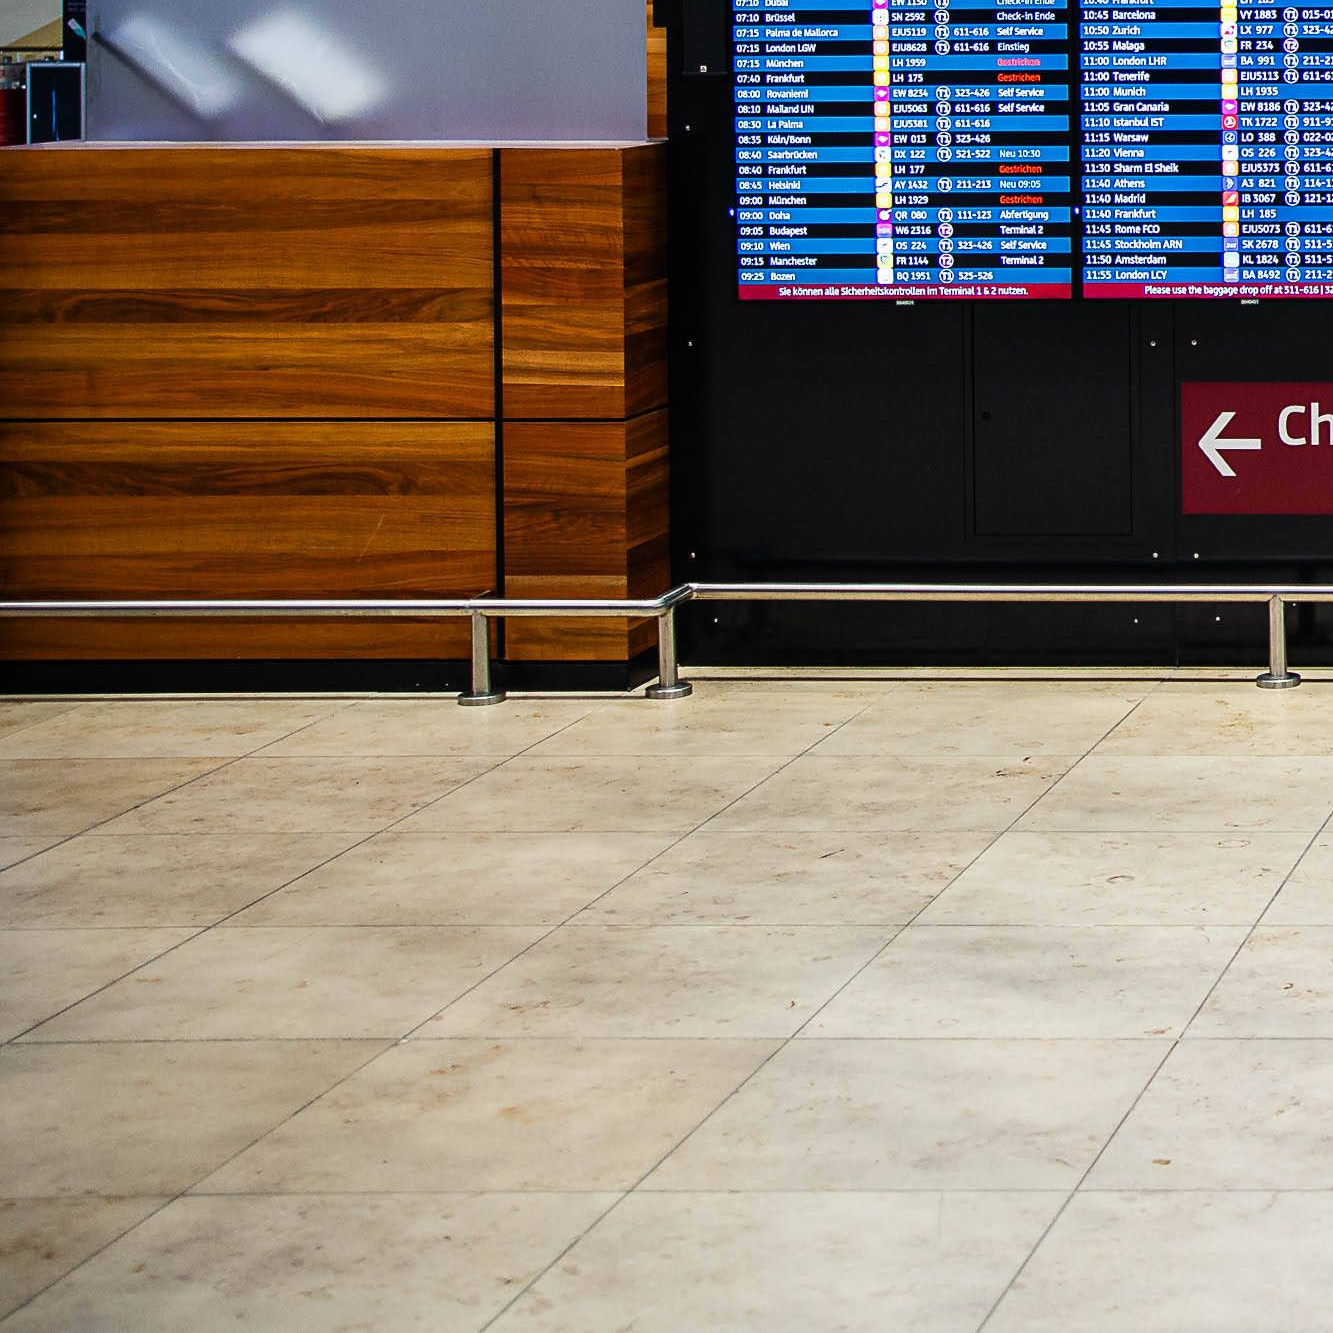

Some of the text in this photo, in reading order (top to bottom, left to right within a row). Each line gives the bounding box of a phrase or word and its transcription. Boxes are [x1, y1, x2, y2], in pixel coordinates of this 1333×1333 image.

[779, 287, 795, 295] Sie
[794, 287, 823, 295] können
[825, 287, 839, 295] alle
[841, 287, 925, 295] Sicherheitskontrollen
[939, 286, 974, 295] Terminal
[1145, 286, 1171, 294] Please
[1188, 286, 1202, 294] the
[1204, 286, 1238, 296] baggage
[1240, 285, 1258, 296] drop
[1260, 285, 1272, 294] off
[1274, 286, 1283, 294] at
[1284, 286, 1319, 294] 511-616
